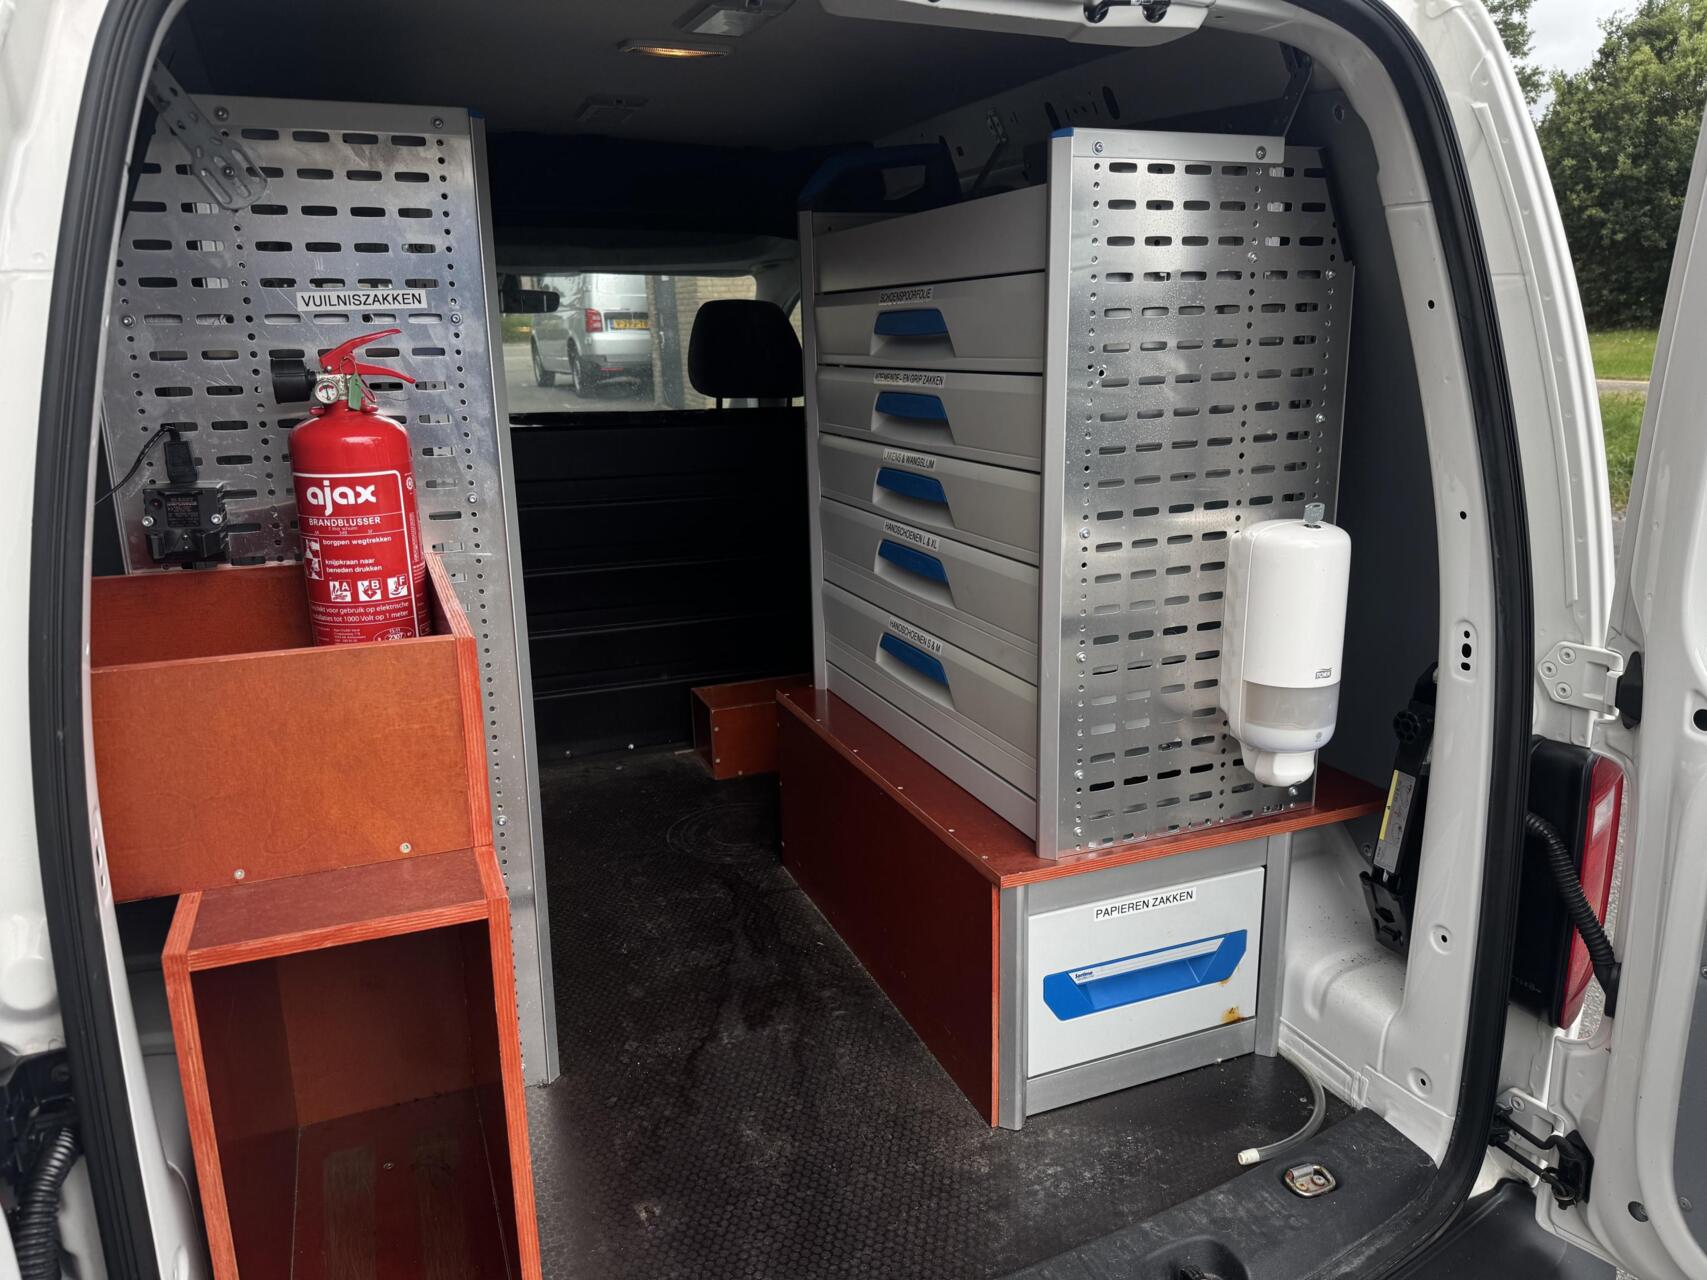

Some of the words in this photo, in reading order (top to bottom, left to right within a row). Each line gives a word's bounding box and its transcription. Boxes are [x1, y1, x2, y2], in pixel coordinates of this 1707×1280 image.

[301, 293, 422, 307] VUILNISZAKKEN
[922, 375, 944, 385] ZAKKEN
[306, 480, 377, 516] ajax
[308, 517, 381, 527] BRANDBLUSSER
[323, 539, 350, 547] borgpen
[352, 536, 392, 545] wegtrekken
[885, 521, 922, 543] HANDSCHOENEN
[930, 539, 937, 549] XL
[325, 559, 358, 567] knijpkraan
[355, 565, 382, 573] drukken
[341, 582, 350, 591] A
[371, 581, 380, 590] B
[399, 576, 406, 586] F
[340, 606, 364, 615] gebruik
[366, 605, 375, 614] op
[376, 602, 409, 611] elektrische
[361, 614, 374, 622] Volt
[391, 610, 409, 618] meter
[889, 620, 927, 646] HANDSCHOENEN
[1096, 899, 1150, 918] PAPIEREN
[1152, 890, 1193, 907] ZAKKEN
